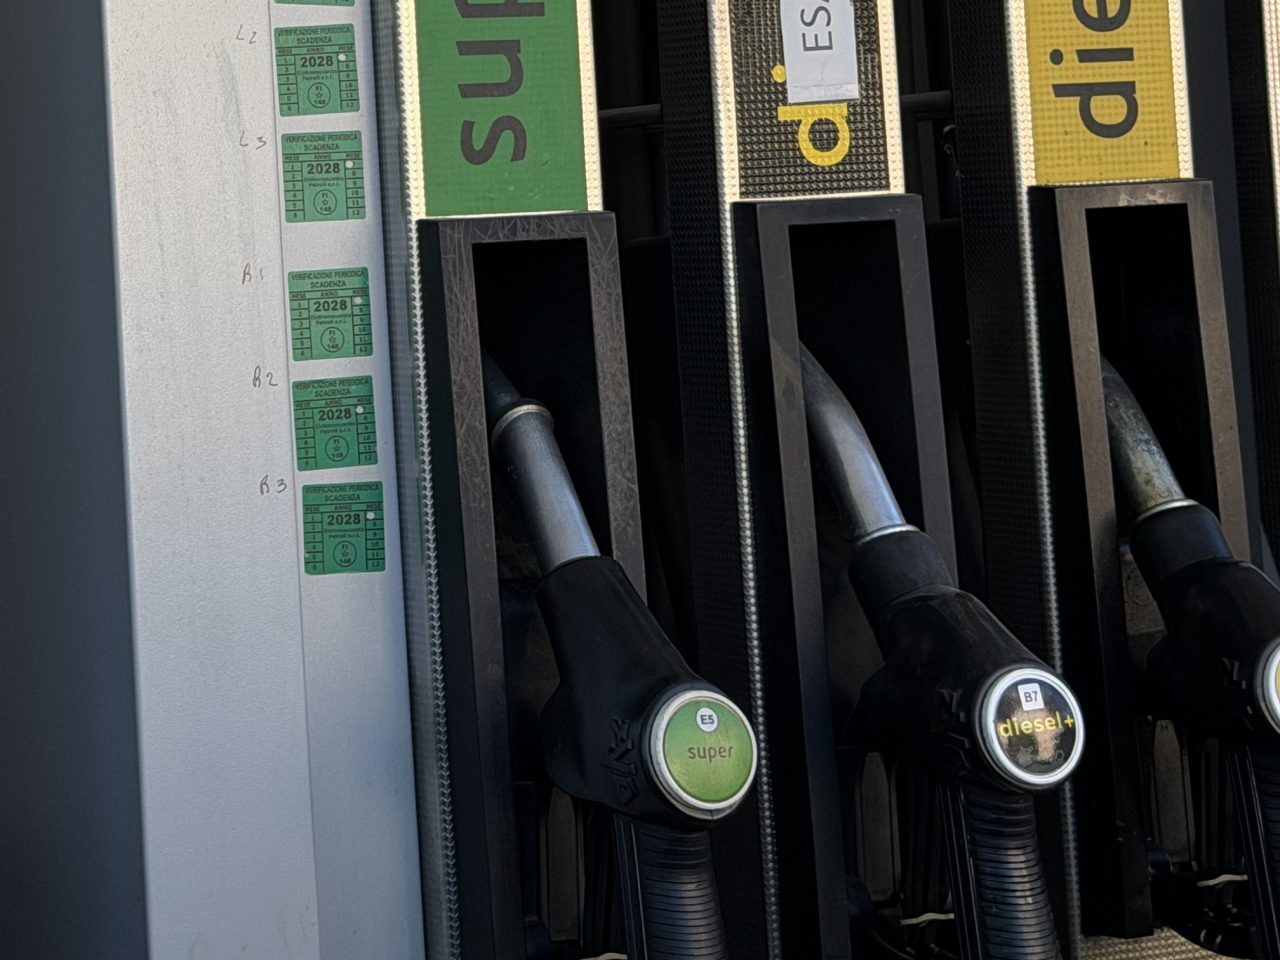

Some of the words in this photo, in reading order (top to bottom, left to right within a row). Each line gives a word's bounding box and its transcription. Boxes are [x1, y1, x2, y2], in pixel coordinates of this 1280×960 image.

[301, 56, 333, 67] 2028
[307, 163, 340, 174] 2028
[310, 280, 346, 289] SCADENZA
[314, 300, 347, 312] 2028
[315, 389, 351, 397] SCADENZA
[318, 408, 351, 421] 2028
[327, 513, 360, 526] 2028
[1024, 691, 1038, 703] B7
[700, 714, 714, 725] E5
[999, 710, 1074, 737] diesel+
[688, 746, 733, 763] super
